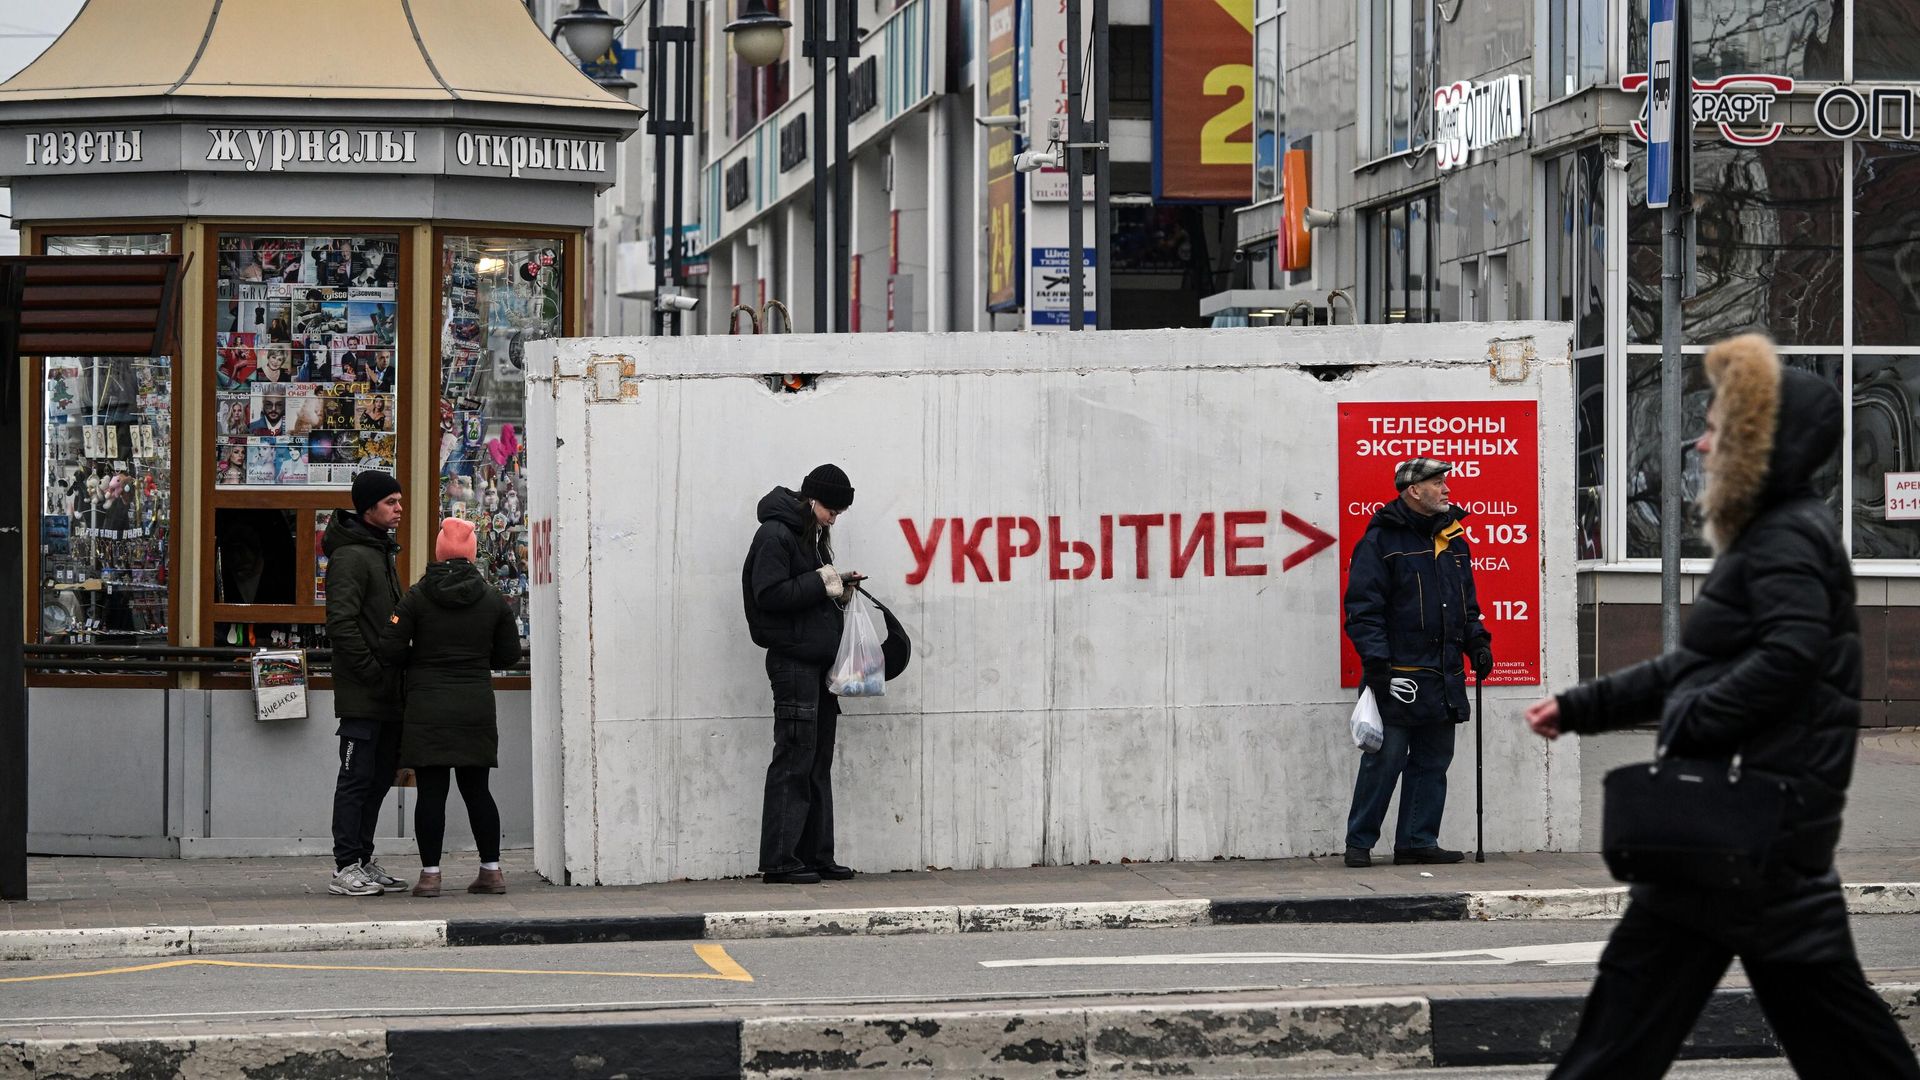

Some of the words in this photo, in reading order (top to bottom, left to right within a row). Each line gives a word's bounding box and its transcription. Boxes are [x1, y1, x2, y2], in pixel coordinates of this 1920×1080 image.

[1202, 63, 1253, 165] 2
[1466, 77, 1513, 148] ОПТИКА
[1640, 95, 1774, 121] КРАФТ
[1814, 86, 1920, 139] ОП
[25, 129, 143, 165] газеты
[206, 128, 417, 171] журналы
[456, 132, 606, 178] открытки
[1368, 417, 1506, 434] ТЕЛЕФОНЫ
[1356, 439, 1519, 456] ЭКСТРЕННЫХ
[1896, 481, 1920, 490] АРЕ
[1348, 502, 1387, 516] СКО
[1451, 501, 1518, 517] МОЩЬ
[1890, 498, 1920, 510] 31-1
[899, 510, 1268, 585] УКРЫТИЕ
[1485, 524, 1528, 544] 103
[1492, 600, 1529, 621] 112
